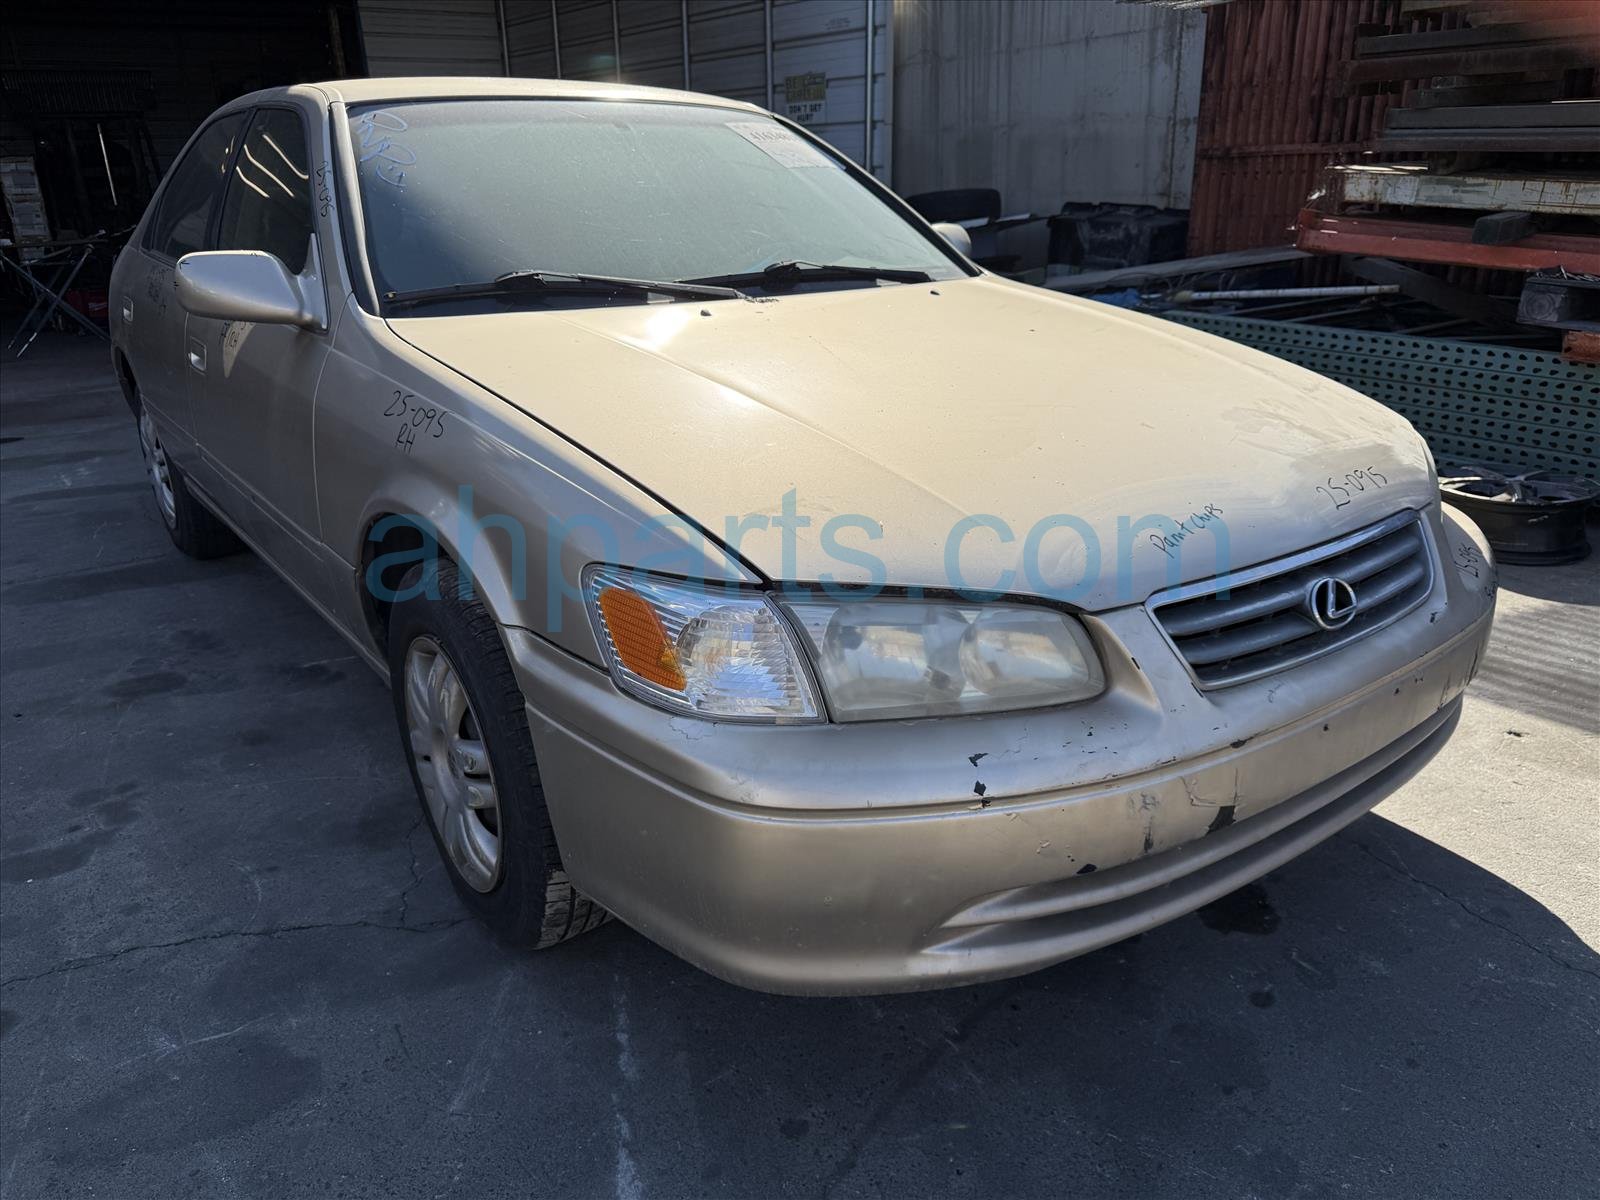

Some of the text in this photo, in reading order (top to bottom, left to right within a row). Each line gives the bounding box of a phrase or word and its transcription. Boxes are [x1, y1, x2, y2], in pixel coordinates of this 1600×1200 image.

[383, 390, 448, 438] 25-095
[395, 422, 415, 454] RH
[1315, 465, 1388, 511] 25-095
